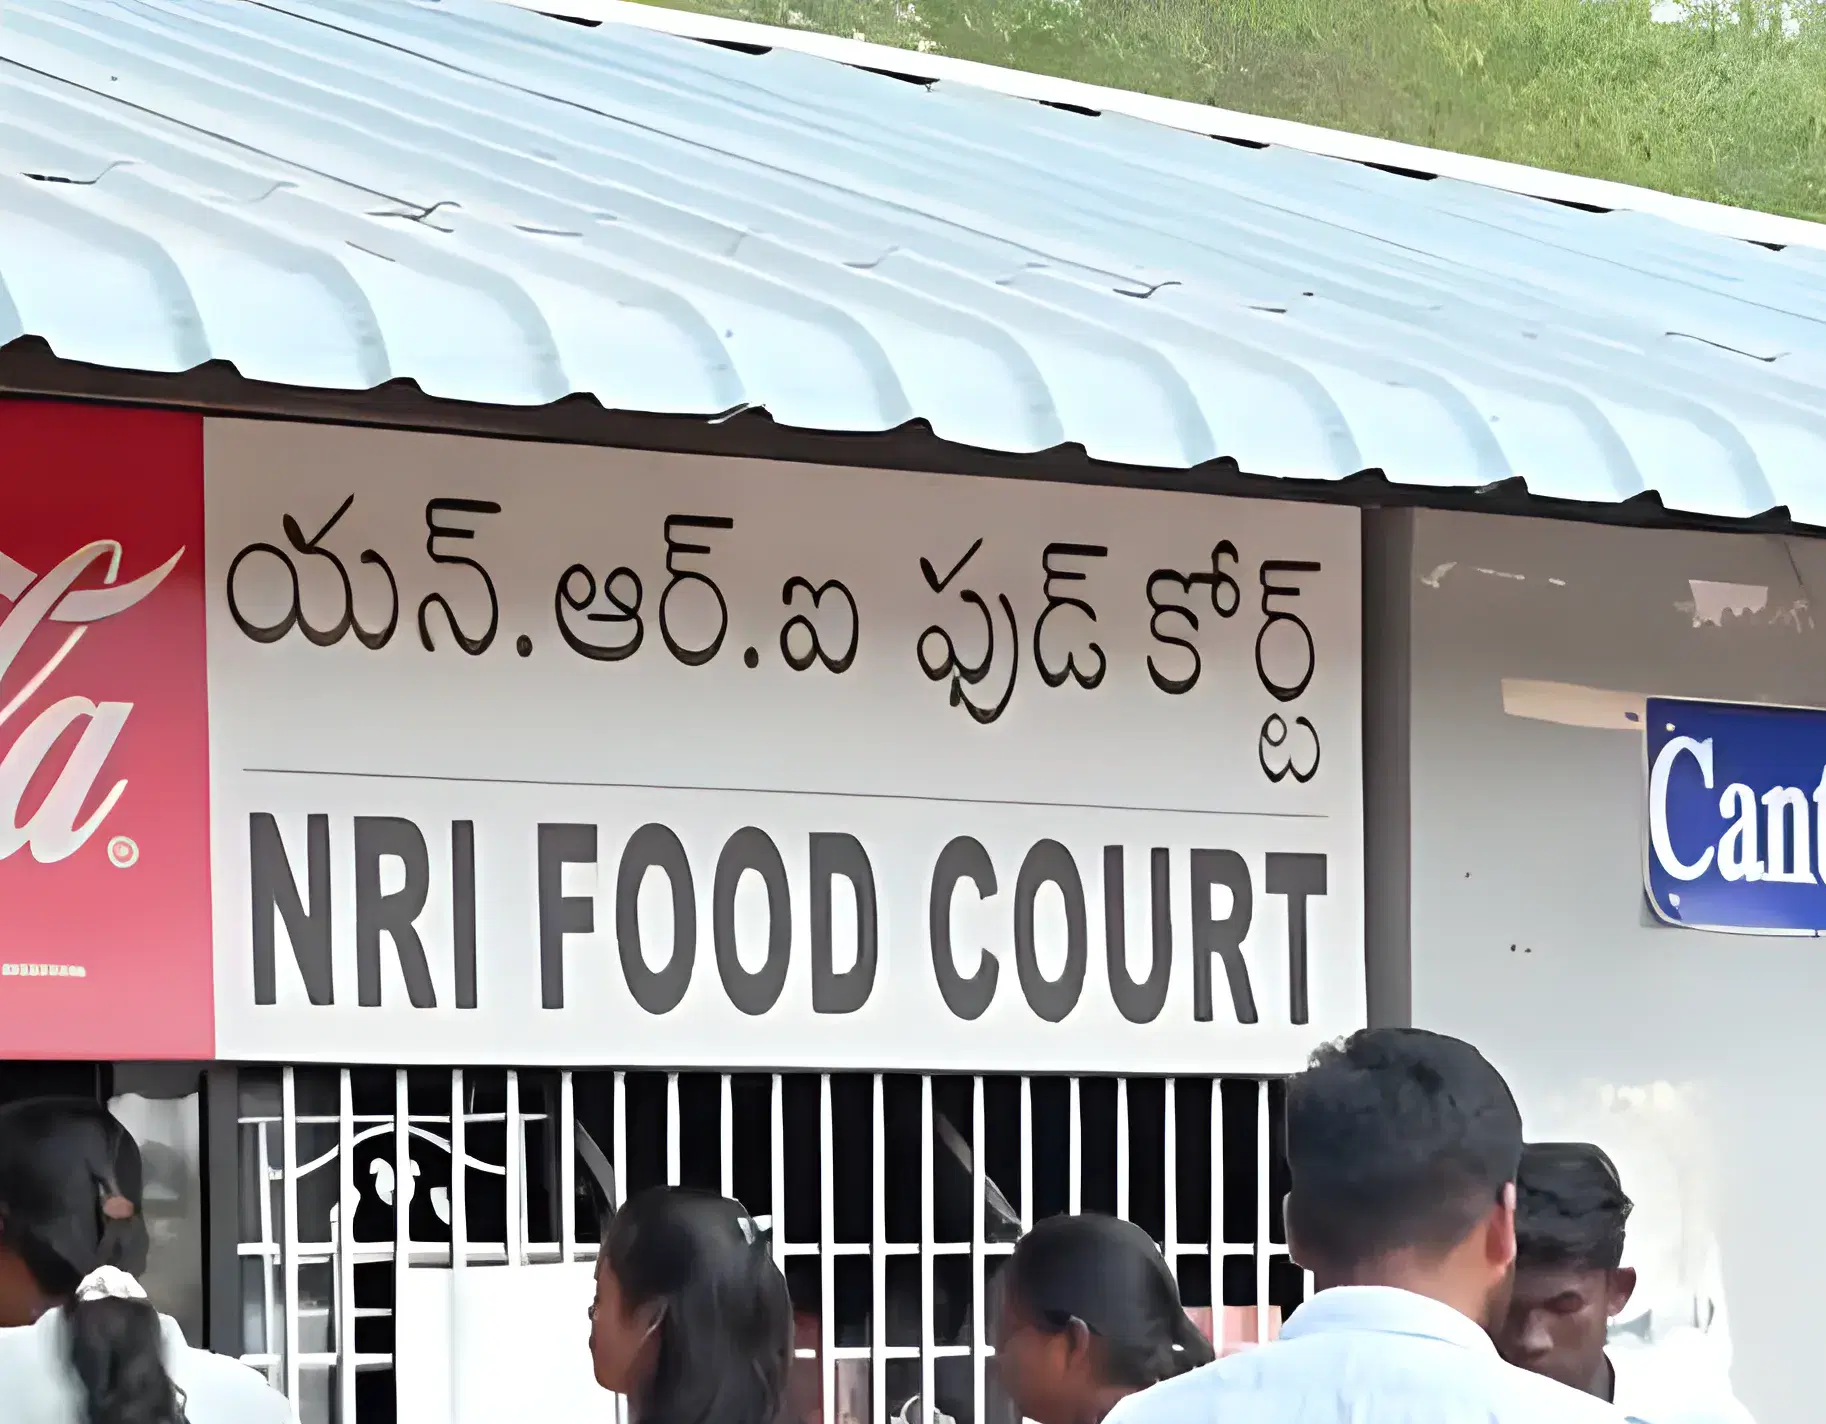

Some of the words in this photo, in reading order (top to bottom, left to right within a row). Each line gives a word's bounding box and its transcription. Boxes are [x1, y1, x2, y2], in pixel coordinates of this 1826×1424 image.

[248, 812, 478, 1009] NRI
[536, 822, 879, 1016] FOOD
[929, 835, 1328, 1025] COURT
